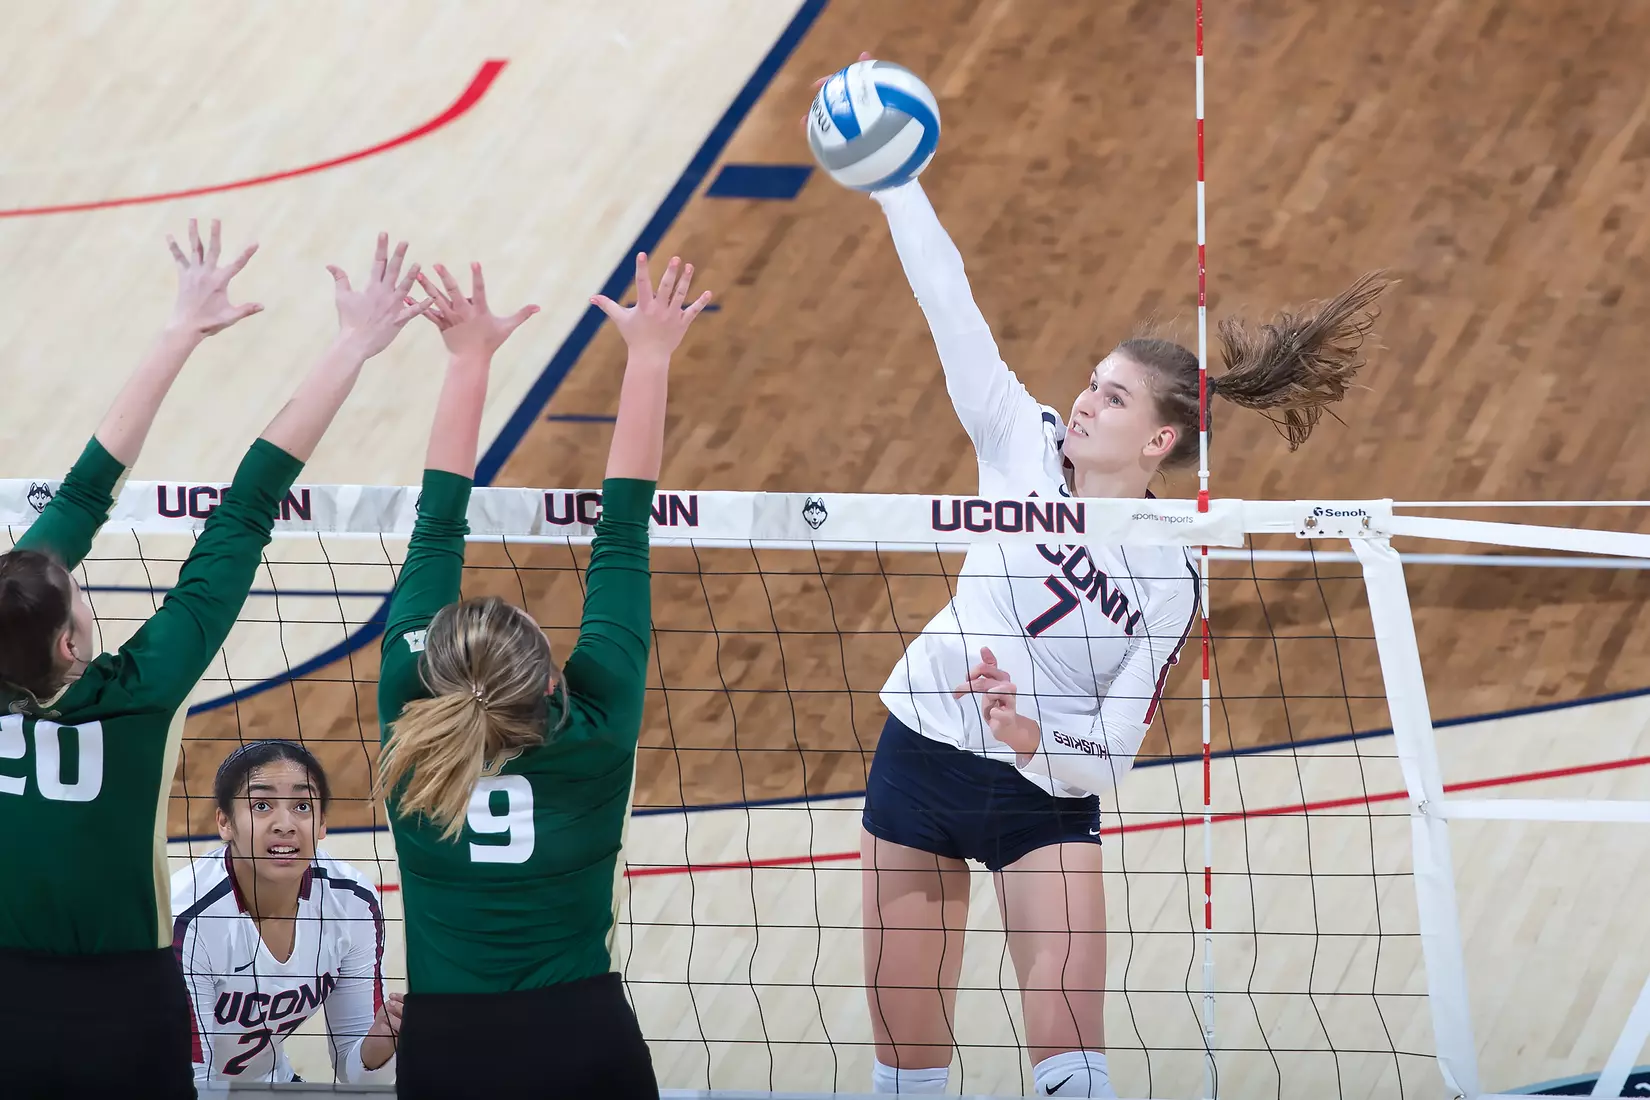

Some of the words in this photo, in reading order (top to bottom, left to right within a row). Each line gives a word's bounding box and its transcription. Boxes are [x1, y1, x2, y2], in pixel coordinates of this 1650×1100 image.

[157, 485, 312, 521] UCN
[544, 492, 699, 527] UCNN
[931, 499, 1085, 533] UCONN
[1325, 508, 1367, 517] Senoh
[1025, 574, 1081, 639] 7
[1052, 730, 1107, 761] HUSKIES
[466, 774, 535, 864] 9
